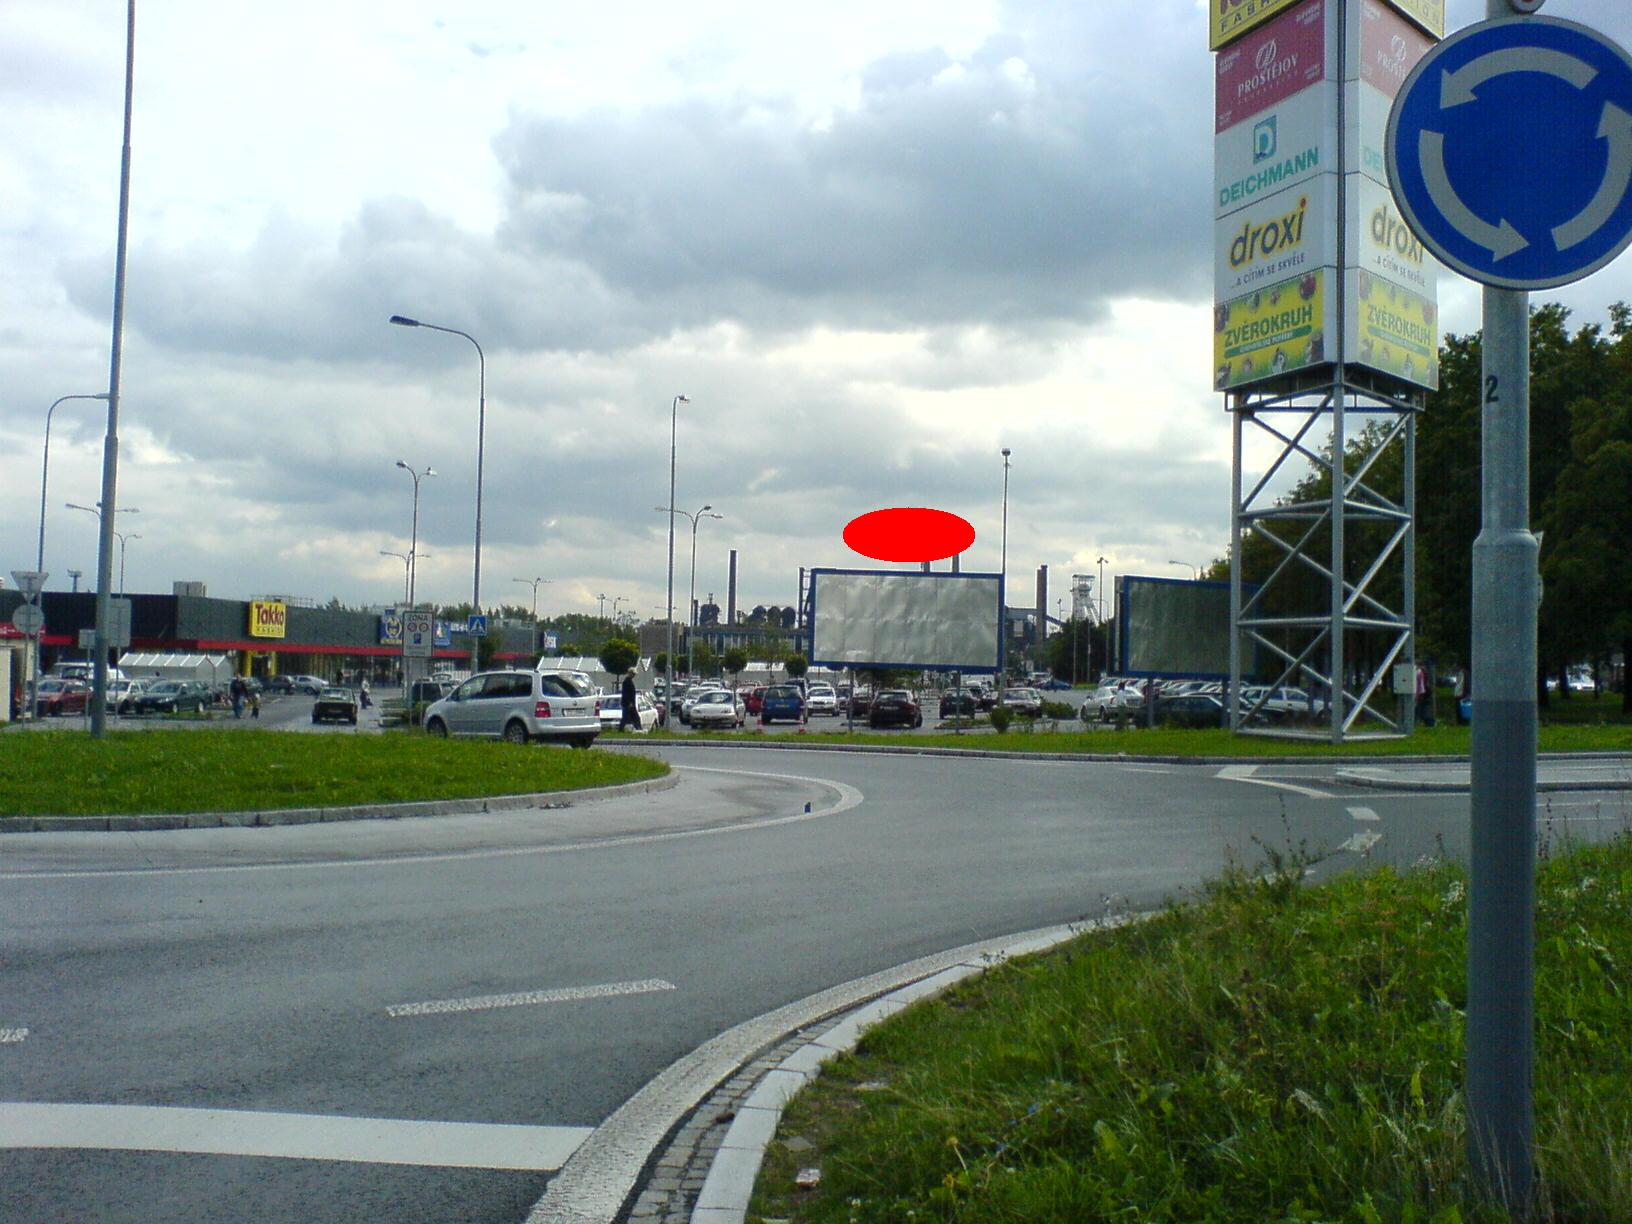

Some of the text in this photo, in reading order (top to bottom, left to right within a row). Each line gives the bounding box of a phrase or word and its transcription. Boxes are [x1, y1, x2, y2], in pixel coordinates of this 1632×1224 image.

[1220, 146, 1319, 207] DEICHMANN
[1230, 197, 1307, 267] droxi
[1486, 374, 1500, 403] 2
[255, 603, 284, 626] Takko
